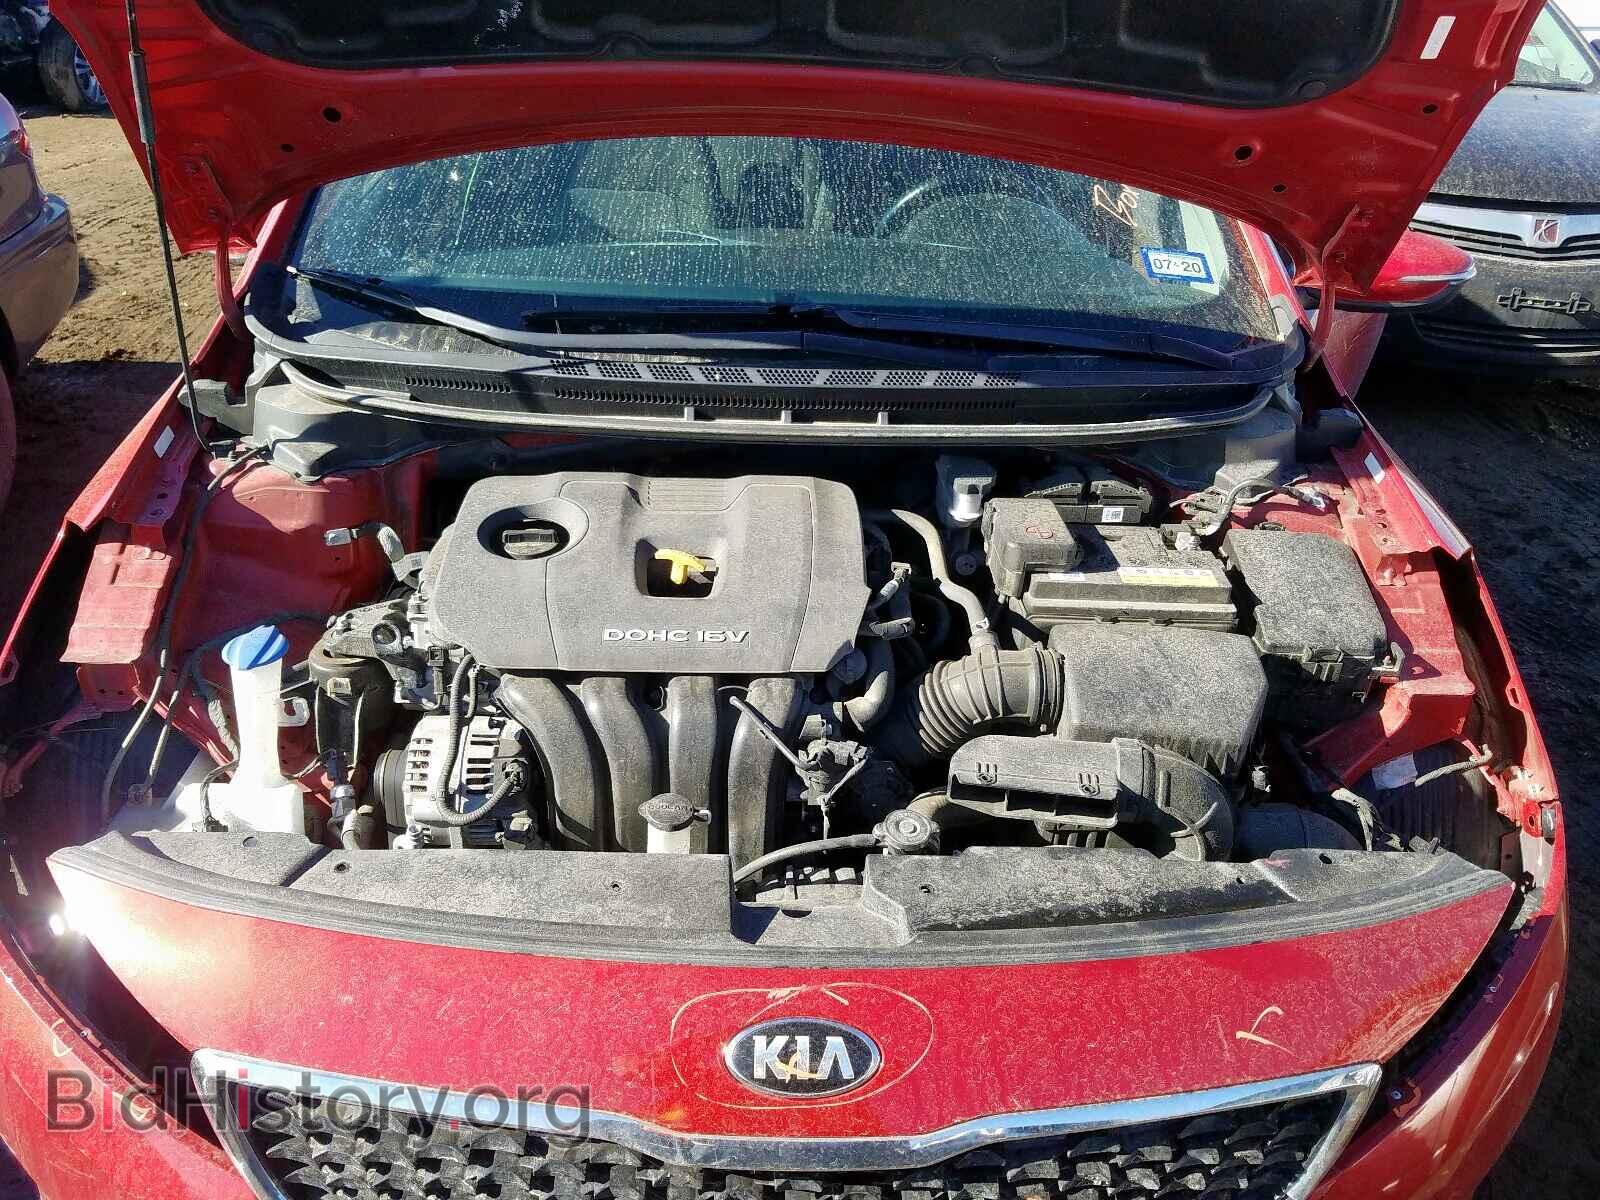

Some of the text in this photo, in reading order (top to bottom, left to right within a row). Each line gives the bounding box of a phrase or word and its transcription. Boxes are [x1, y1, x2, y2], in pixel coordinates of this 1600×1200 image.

[603, 628, 749, 643] DOHC 16V
[752, 1035, 855, 1080] KIA
